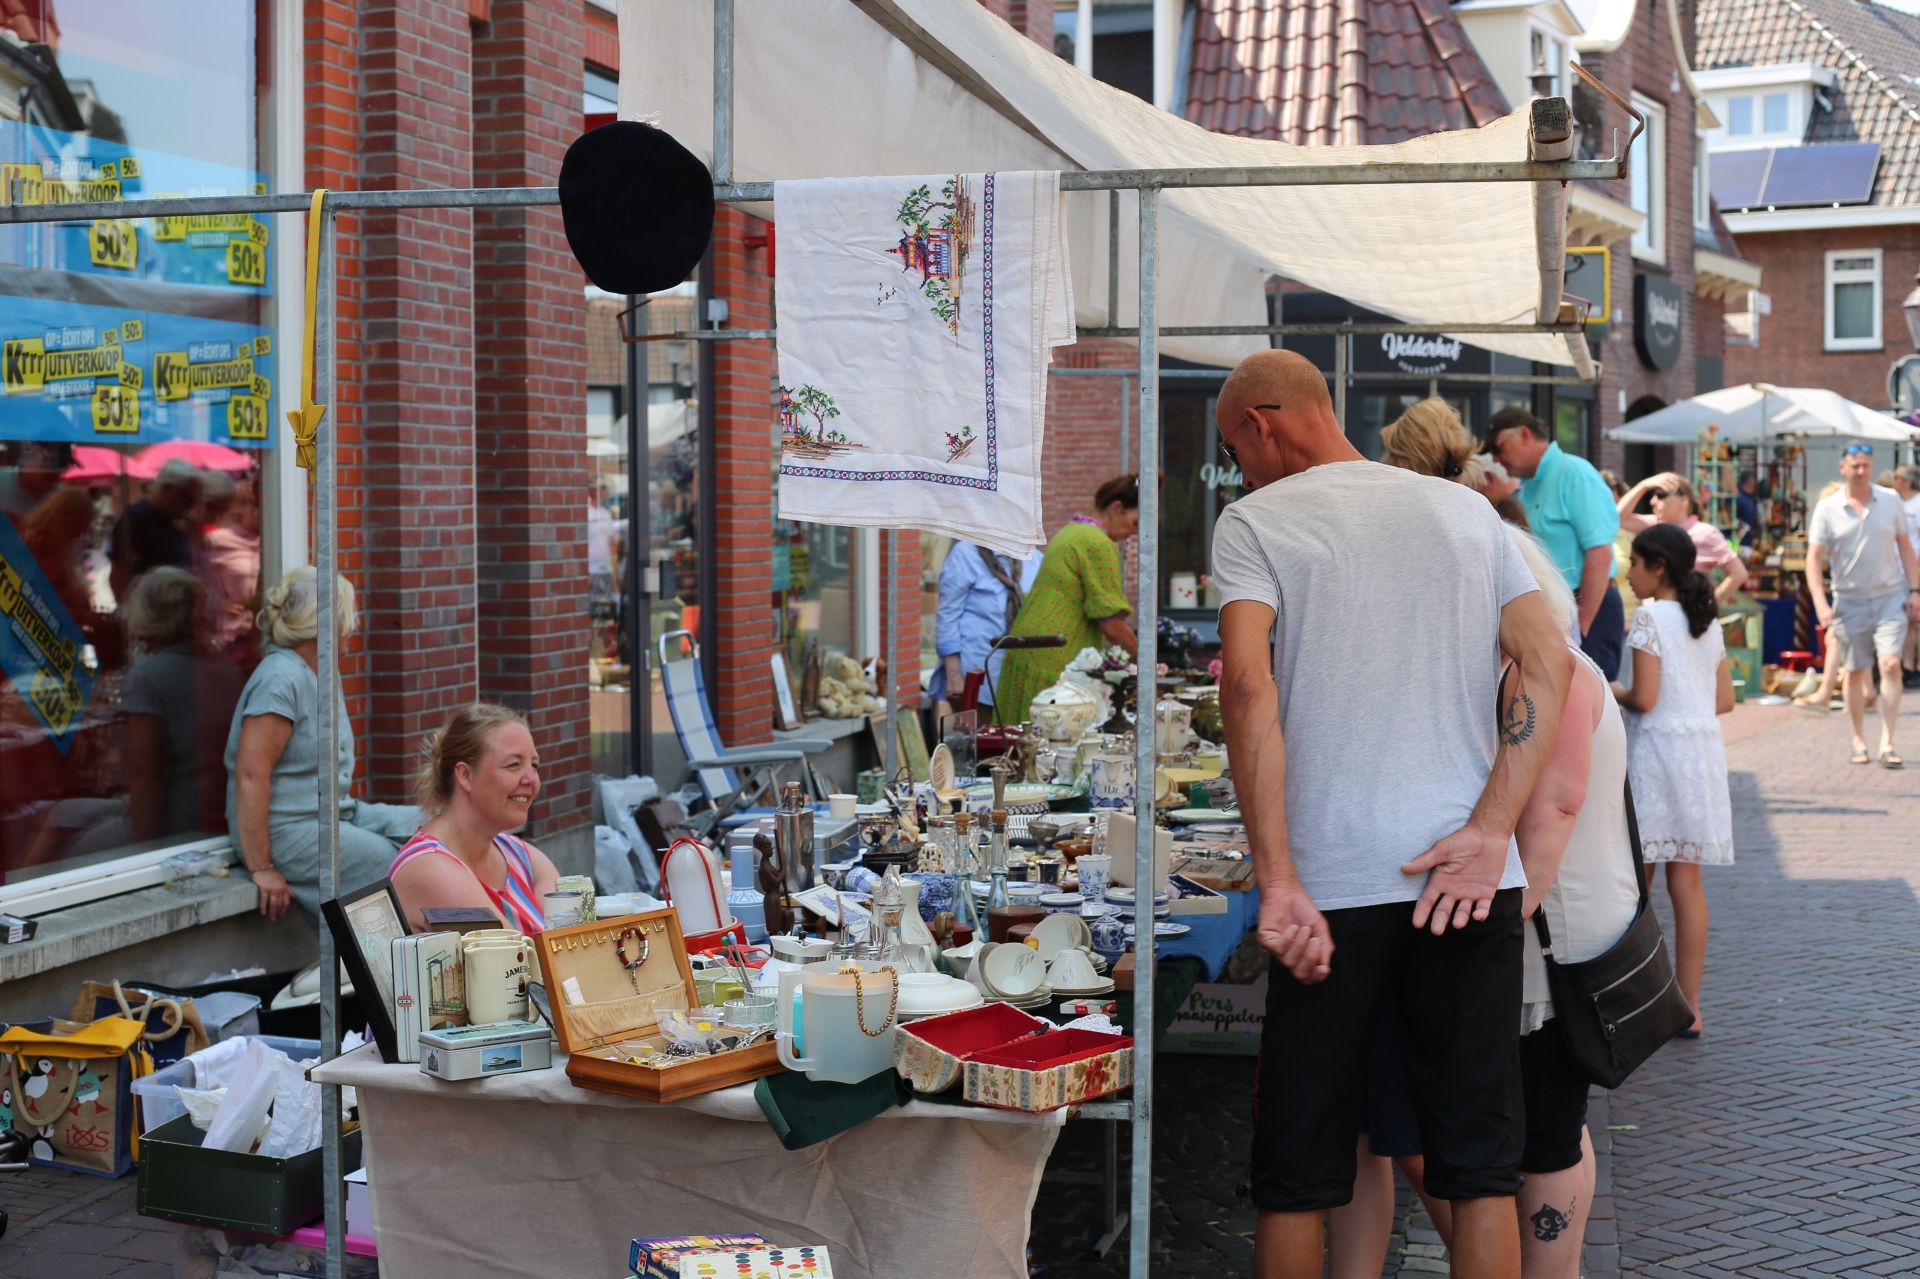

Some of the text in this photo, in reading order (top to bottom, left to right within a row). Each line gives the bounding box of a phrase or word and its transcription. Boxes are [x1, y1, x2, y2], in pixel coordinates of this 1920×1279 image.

[97, 222, 132, 263] 50%
[231, 243, 261, 279] 50%
[124, 321, 141, 339] 50%
[48, 350, 119, 377] UITVERKOOP
[191, 363, 251, 387] UITVERKOOP
[98, 390, 133, 427] 50%
[232, 400, 263, 433] 50%
[1189, 991, 1234, 1012] Pers
